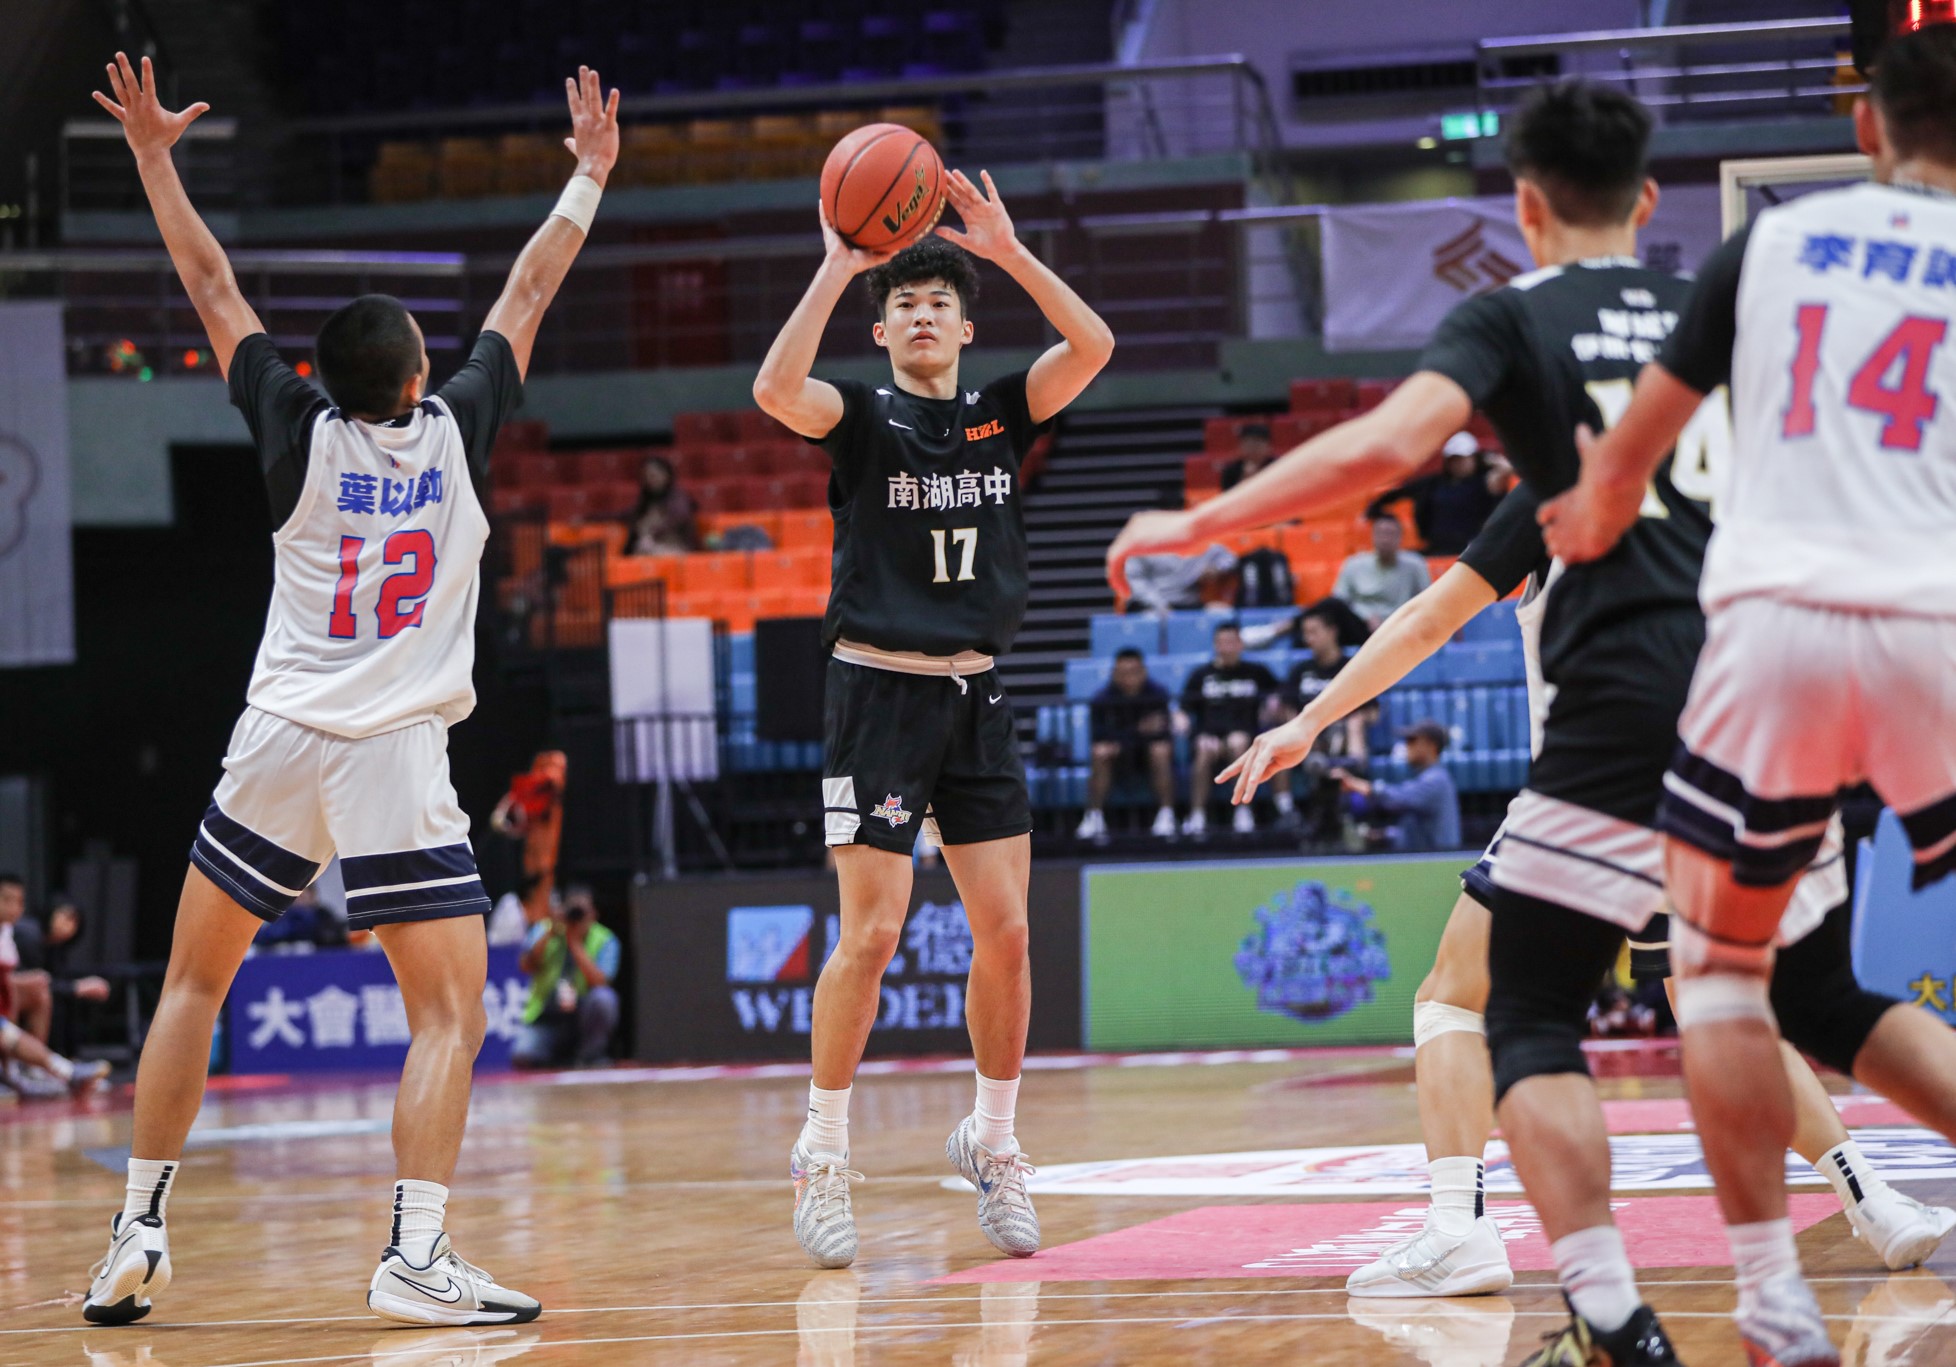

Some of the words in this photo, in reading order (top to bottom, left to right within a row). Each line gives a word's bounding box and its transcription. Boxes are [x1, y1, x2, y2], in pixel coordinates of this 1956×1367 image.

[1782, 303, 1948, 453] 14
[887, 466, 1011, 511] 南湖高中
[328, 528, 438, 639] 12
[930, 527, 978, 583] 17
[247, 981, 532, 1048] 大會醫站
[1908, 972, 1956, 1012] 大
